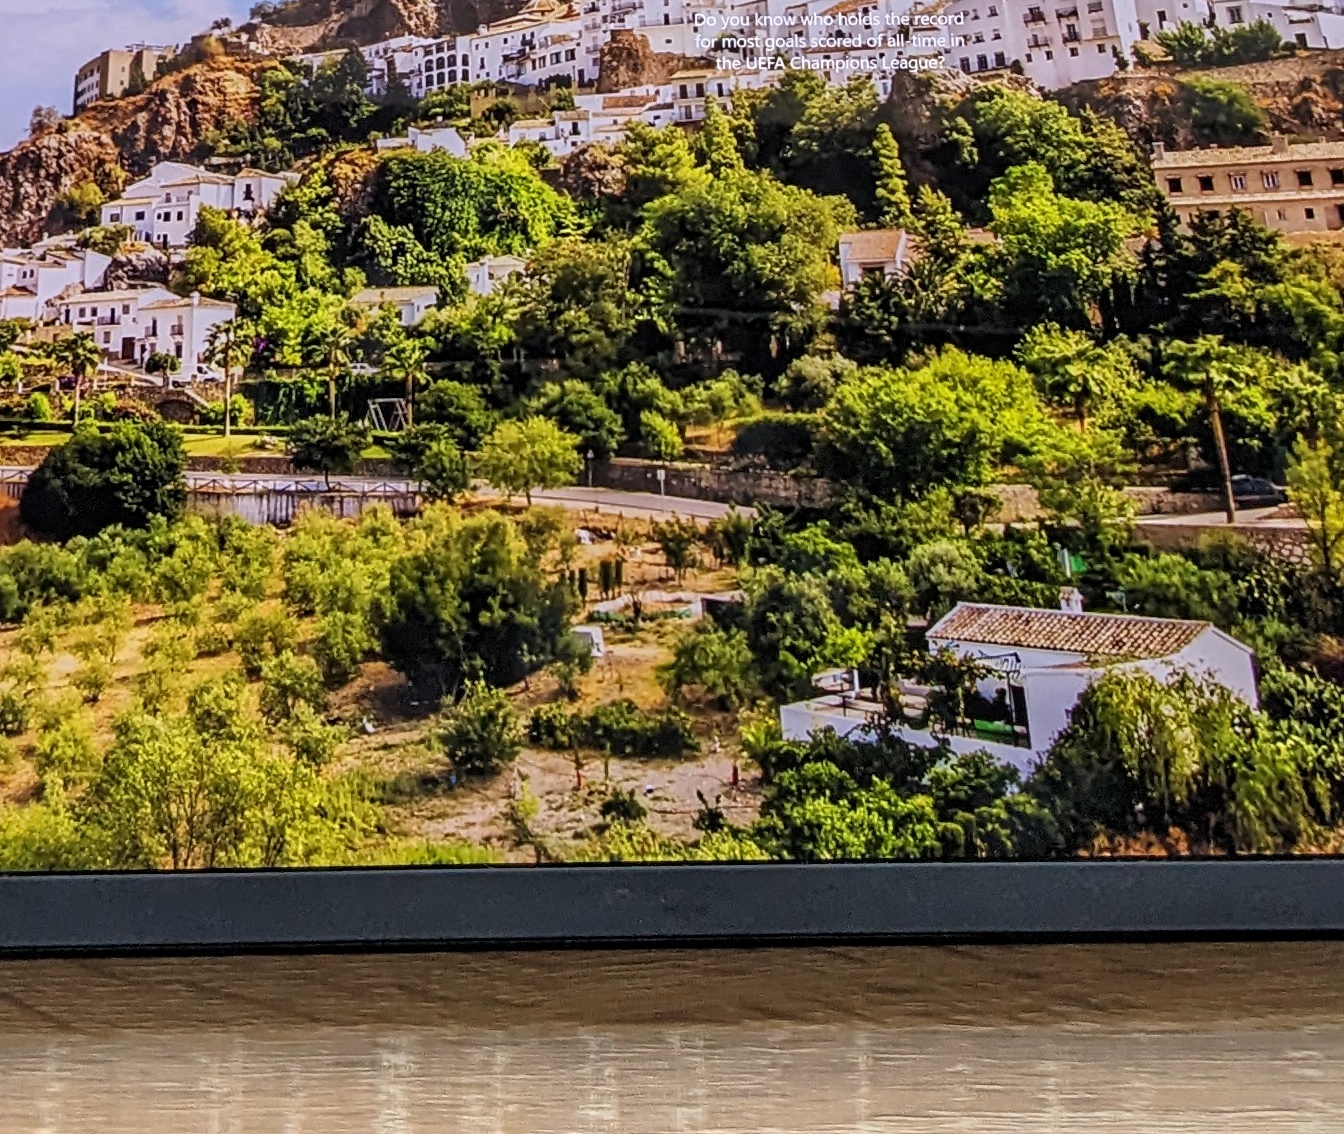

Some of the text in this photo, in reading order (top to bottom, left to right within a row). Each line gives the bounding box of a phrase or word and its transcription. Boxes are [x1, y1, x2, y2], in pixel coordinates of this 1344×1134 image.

[694, 12, 964, 30] Do you know who holds the record
[695, 34, 964, 51] for most goals scored of all-time in
[717, 56, 945, 73] the UEFA Champions League?
